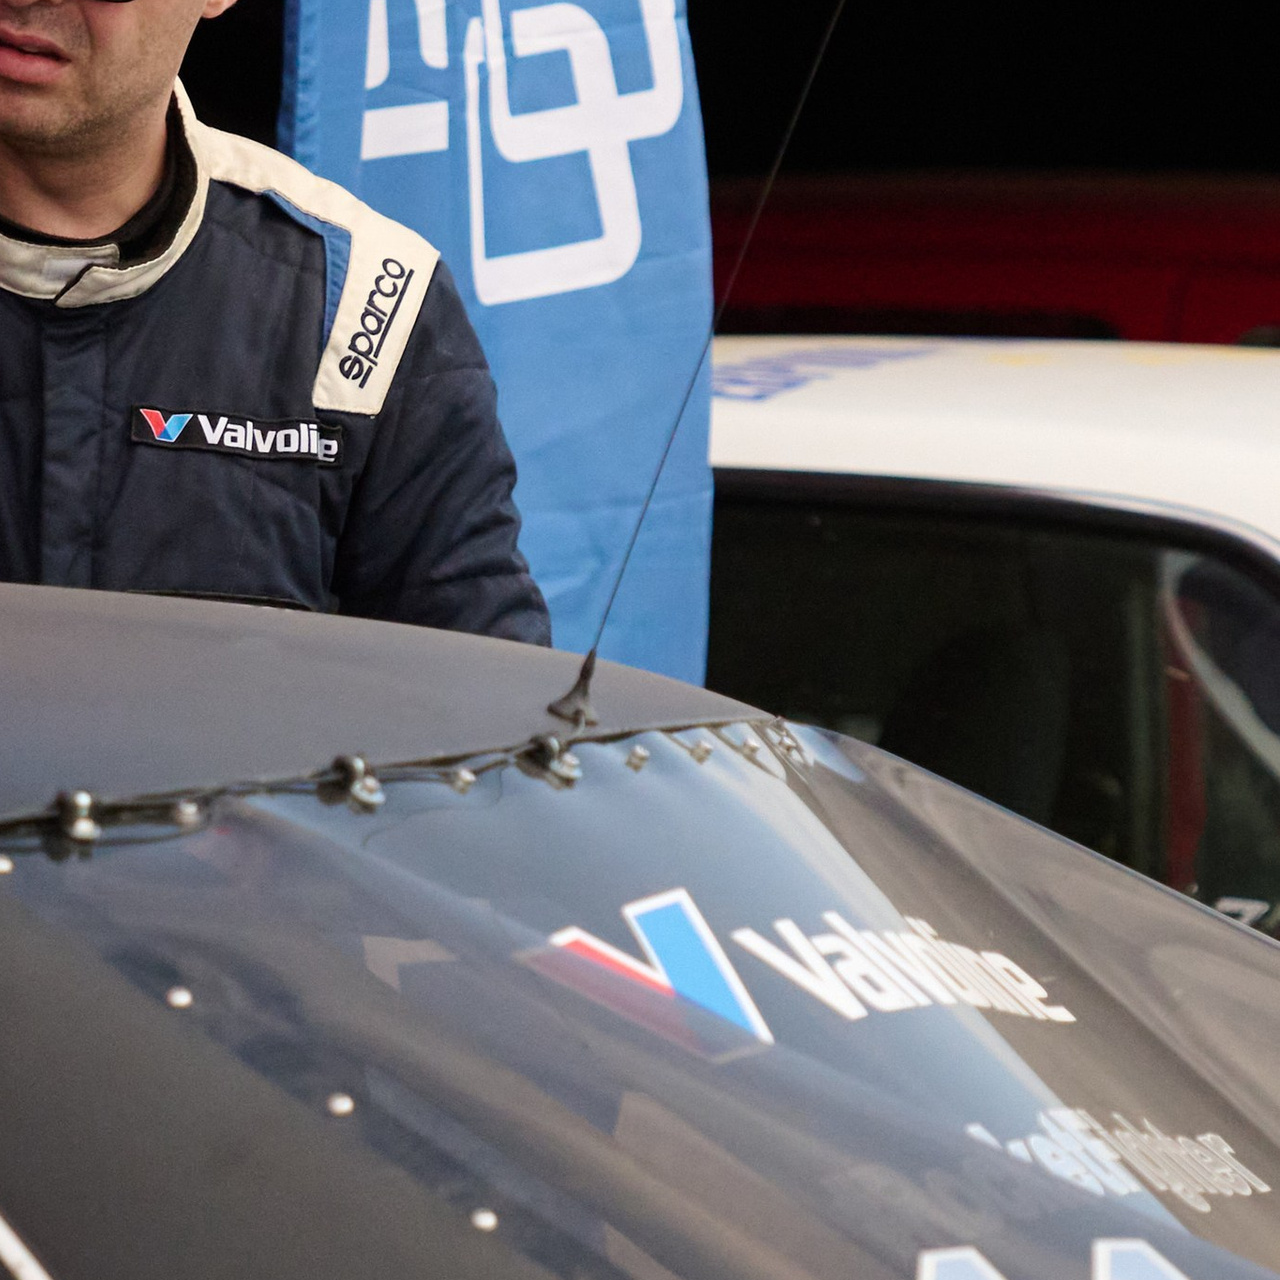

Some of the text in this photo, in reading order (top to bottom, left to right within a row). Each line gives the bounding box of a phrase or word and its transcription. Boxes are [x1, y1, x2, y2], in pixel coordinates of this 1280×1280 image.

[338, 257, 410, 383] sparco
[196, 414, 339, 463] Valvolie
[730, 909, 1078, 1023] Valvoline
